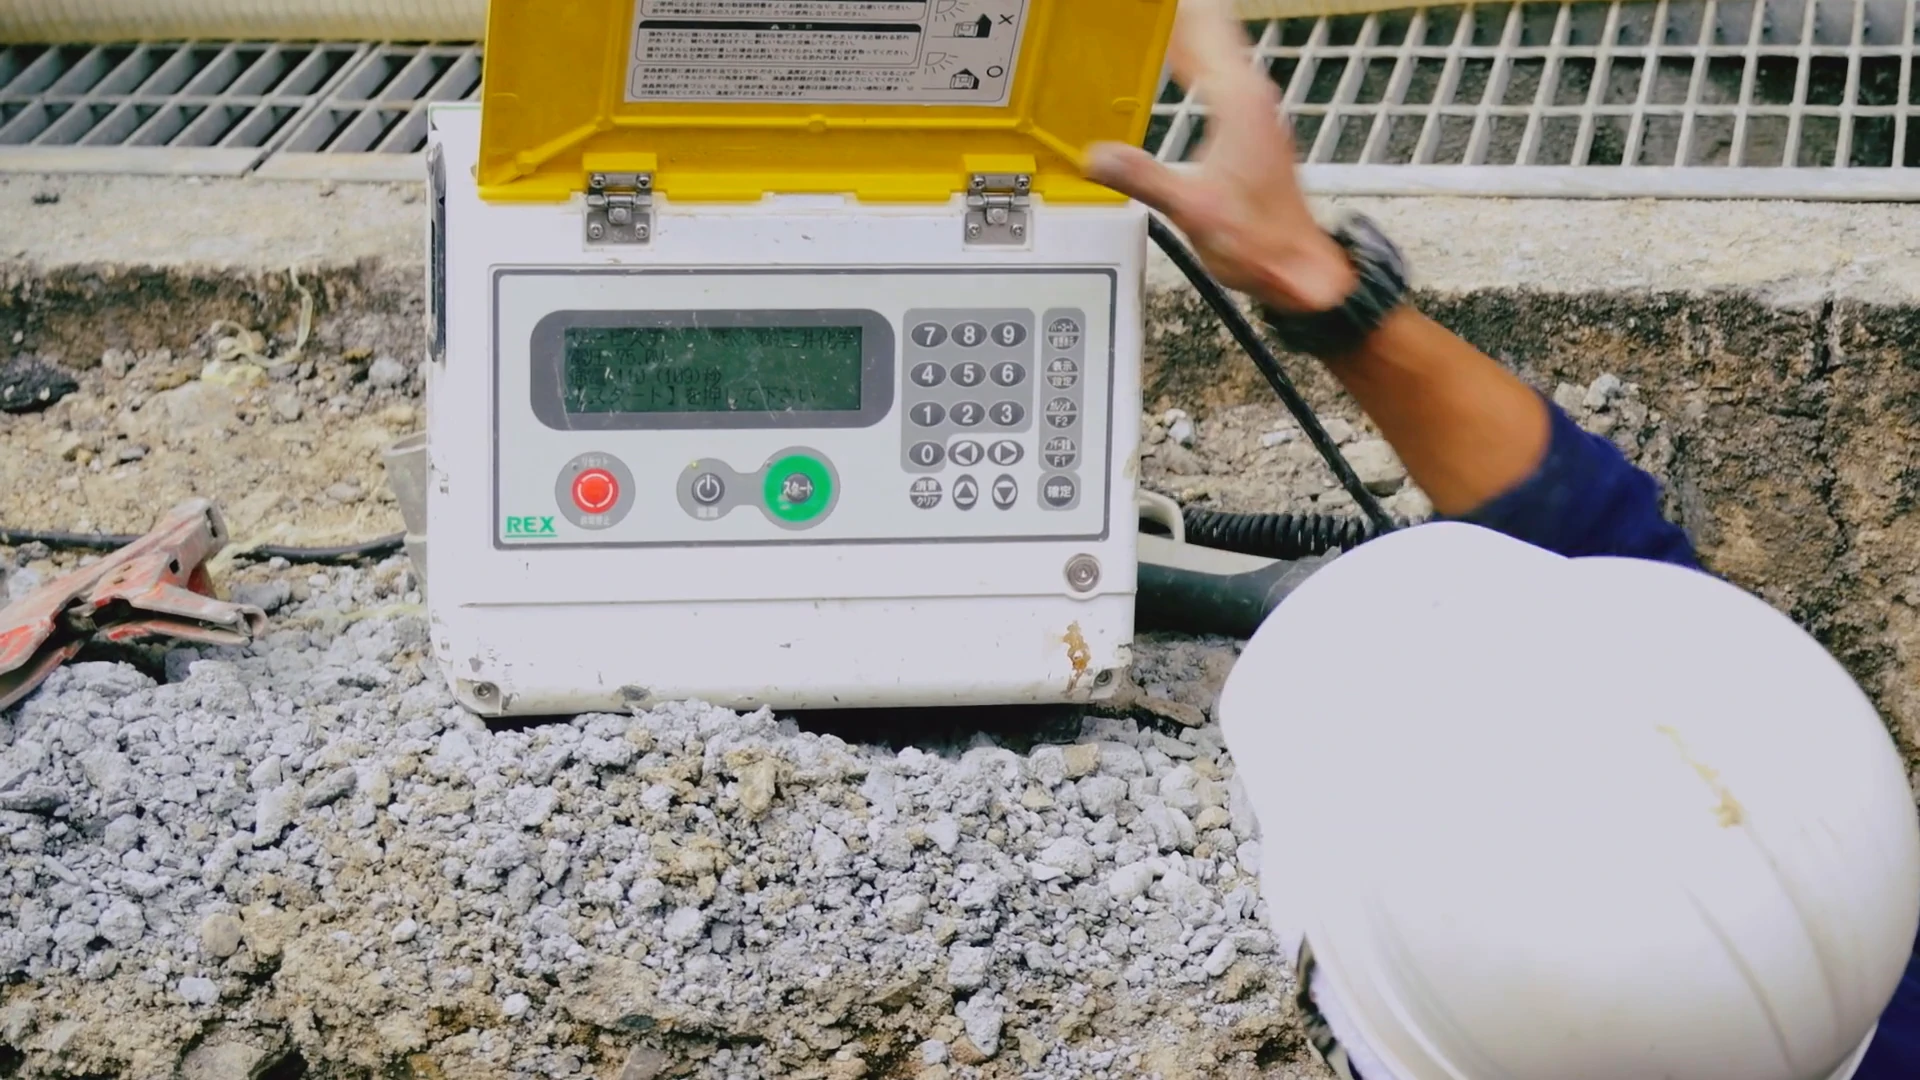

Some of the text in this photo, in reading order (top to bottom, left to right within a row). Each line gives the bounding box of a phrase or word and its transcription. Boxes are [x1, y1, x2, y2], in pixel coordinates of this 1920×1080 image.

[924, 325, 1015, 345] 7 8 9
[922, 364, 1014, 384] 4 5 6
[923, 404, 1013, 424] 1 2 3
[1055, 416, 1068, 426] F2
[921, 444, 933, 463] 0
[1054, 456, 1066, 466] F1
[917, 497, 938, 507] クリア
[506, 516, 555, 533] REX
